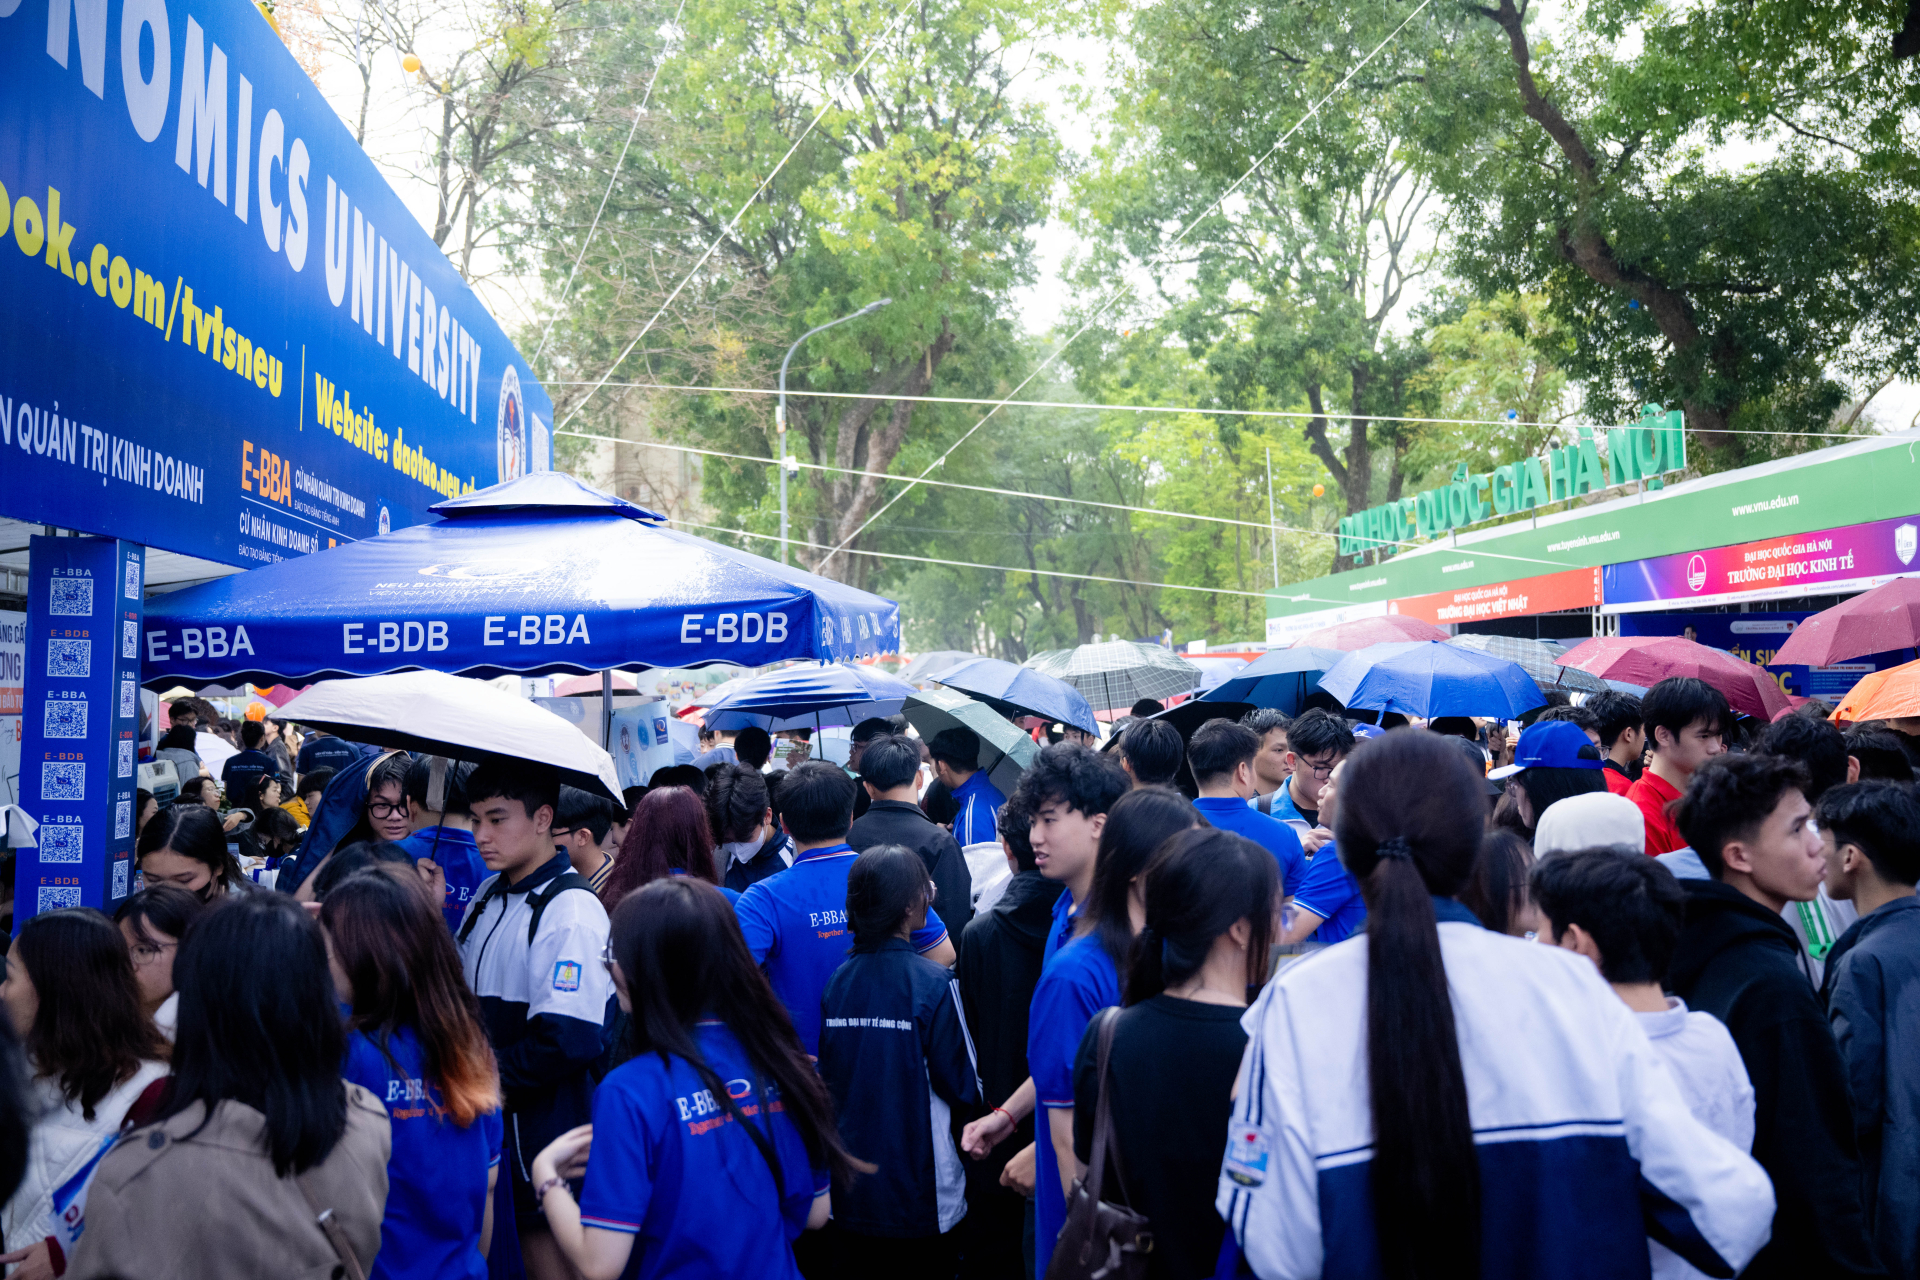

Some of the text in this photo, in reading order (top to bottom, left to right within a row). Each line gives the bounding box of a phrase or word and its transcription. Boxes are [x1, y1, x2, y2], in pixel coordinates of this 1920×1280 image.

[325, 174, 481, 424] UNIVERSITY
[315, 372, 389, 464] Website:
[17, 401, 77, 465] QUẢN
[81, 424, 109, 487] TRỊ
[112, 436, 152, 488] KINH
[154, 452, 204, 504] DOANH
[241, 440, 292, 508] E-BBA
[1339, 403, 1686, 564] ĐẠI HỌC QUỐC GIA HÀ NỘI
[319, 479, 333, 504] QUẢN
[351, 496, 366, 519] DOANH
[1732, 495, 1799, 517] www.vnu.edu.vn
[240, 508, 251, 535] CỬ
[251, 514, 271, 542] NHÂN
[272, 523, 288, 548] KINH
[289, 529, 311, 555] DOANH
[1547, 530, 1620, 553] www.tuyensinh.vnu.edu.vn
[127, 551, 140, 561] E-BBA
[1745, 538, 1832, 563] ĐẠI HỌC QUỐC GIA HÀ NỘI
[53, 568, 92, 577] E-BBA
[1727, 548, 1854, 584] TRƯỜNG ĐẠI HỌC KINH TẾ
[1463, 604, 1475, 619] ĐẠI
[1476, 602, 1491, 617] HỌC
[1491, 597, 1508, 615] VIỆT
[1508, 594, 1528, 613] NHẬT
[14, 621, 26, 644] CẤ
[51, 629, 90, 638] E-BDB
[343, 621, 450, 654] E-BDB
[484, 615, 592, 646] E-BBA
[681, 612, 790, 643] E-BDB
[147, 625, 255, 662] E-BBA
[122, 671, 135, 679] E-BBA
[47, 690, 87, 699] E-BBA
[45, 752, 84, 761] E-BDB
[117, 791, 131, 800] E-BBA
[43, 814, 82, 823] E-BBA
[40, 876, 80, 885] E-BDB
[809, 909, 848, 928] E-BBA
[817, 929, 844, 939] Together
[385, 1078, 426, 1102] E-BB
[676, 1088, 721, 1121] E-BB
